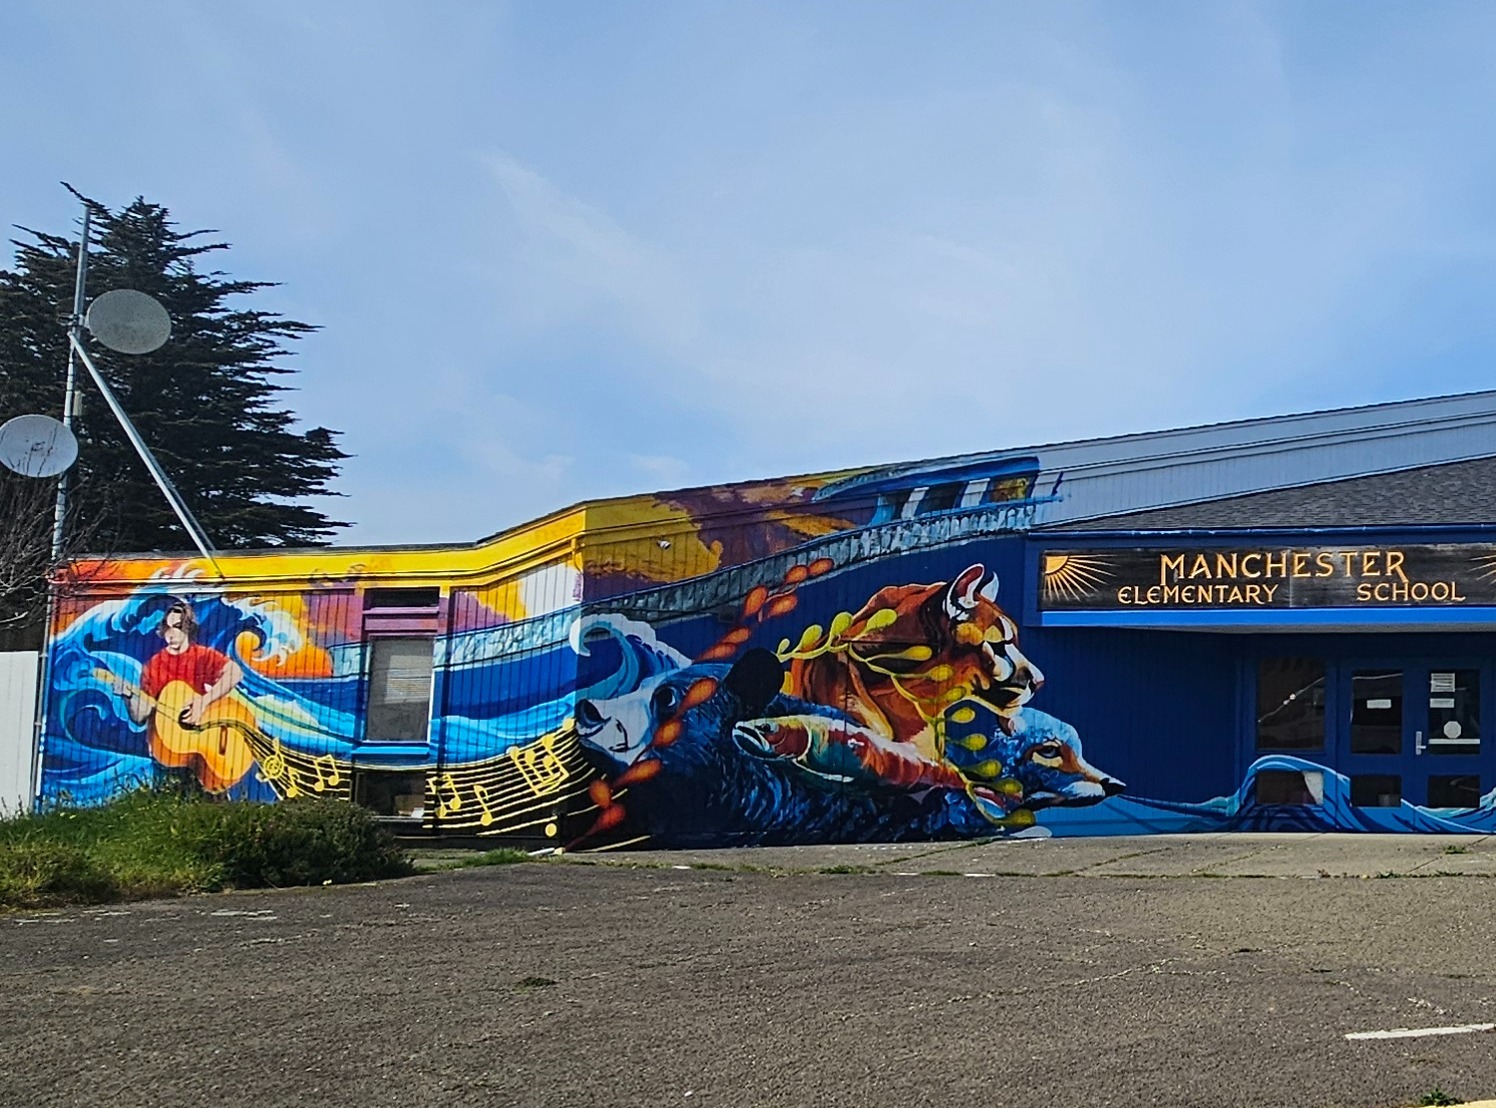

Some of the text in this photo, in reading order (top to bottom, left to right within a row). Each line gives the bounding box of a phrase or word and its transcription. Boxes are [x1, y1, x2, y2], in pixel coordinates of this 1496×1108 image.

[1161, 552, 1409, 584] MANCHESTER
[1118, 582, 1466, 605] ELEMENTARY SCHOOL
